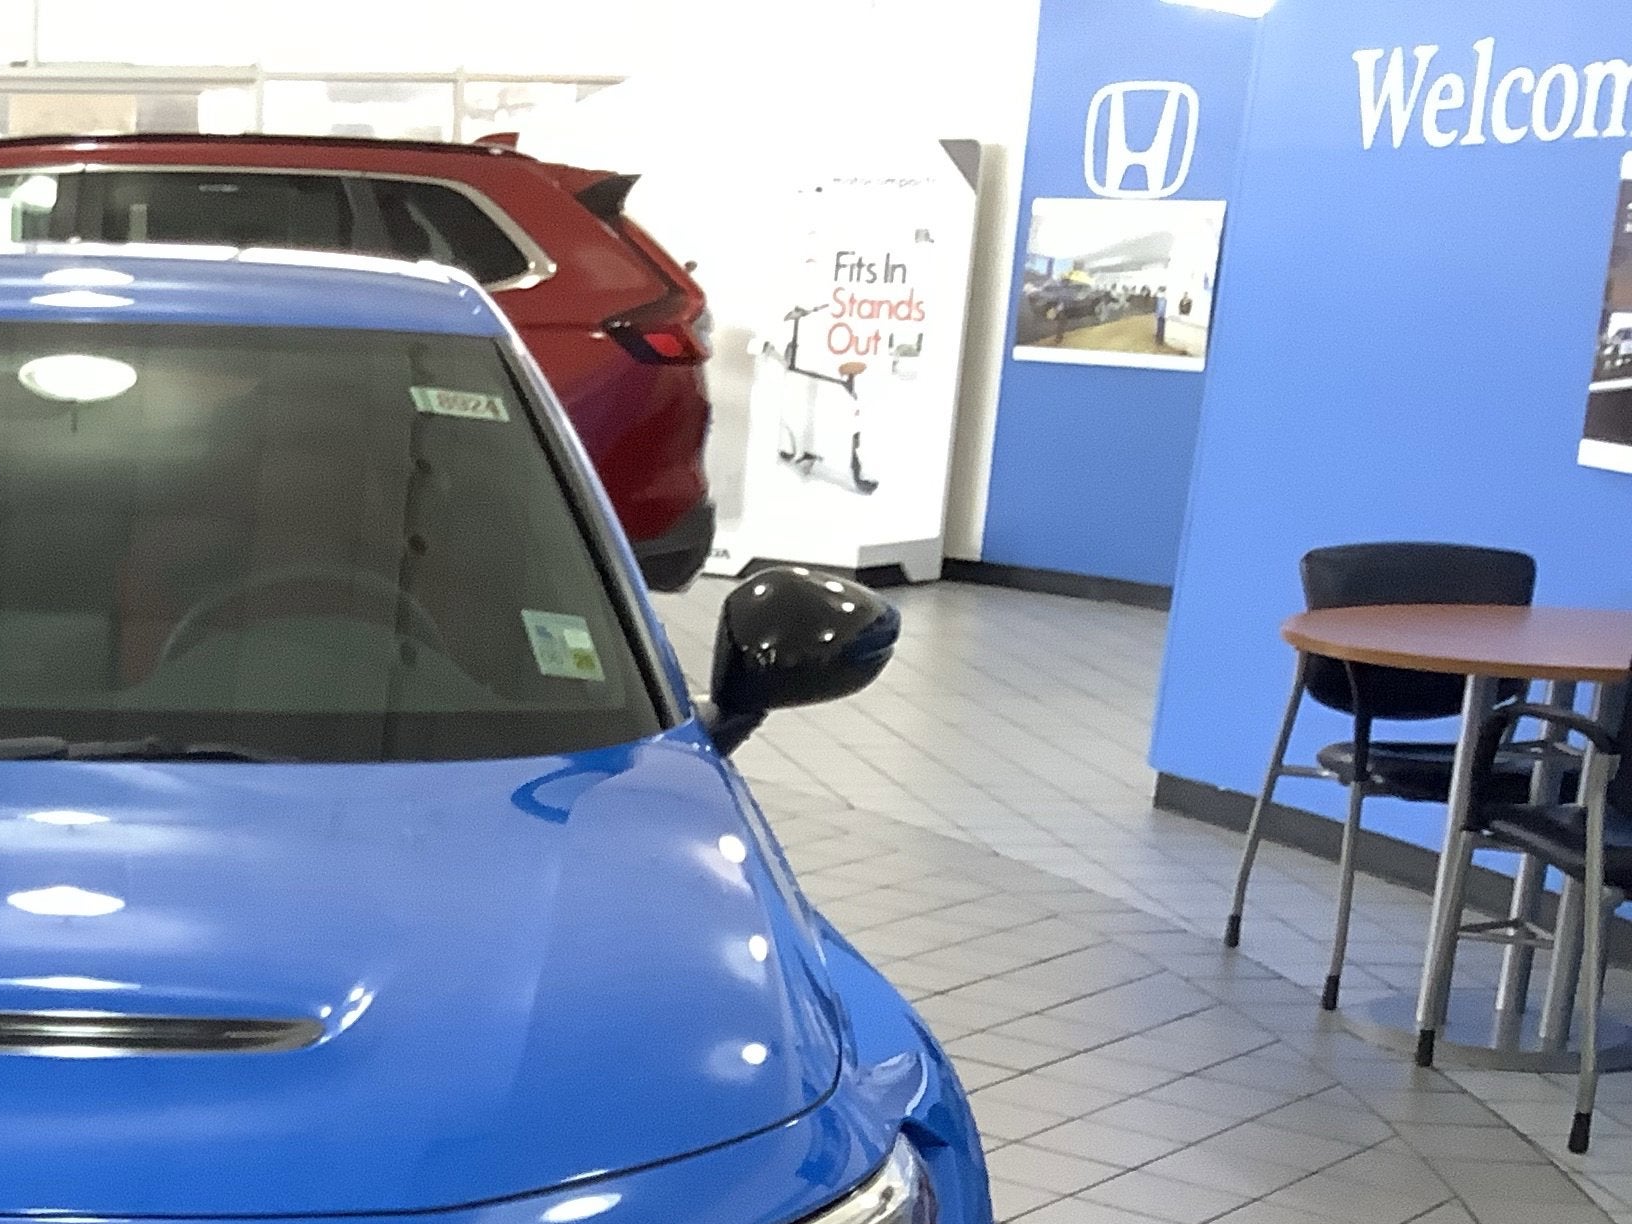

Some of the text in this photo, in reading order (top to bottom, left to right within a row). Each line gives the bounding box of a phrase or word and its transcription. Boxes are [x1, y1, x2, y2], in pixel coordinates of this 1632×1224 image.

[834, 250, 908, 284] Fits In
[831, 286, 926, 322] Stands
[827, 322, 882, 356] Out
